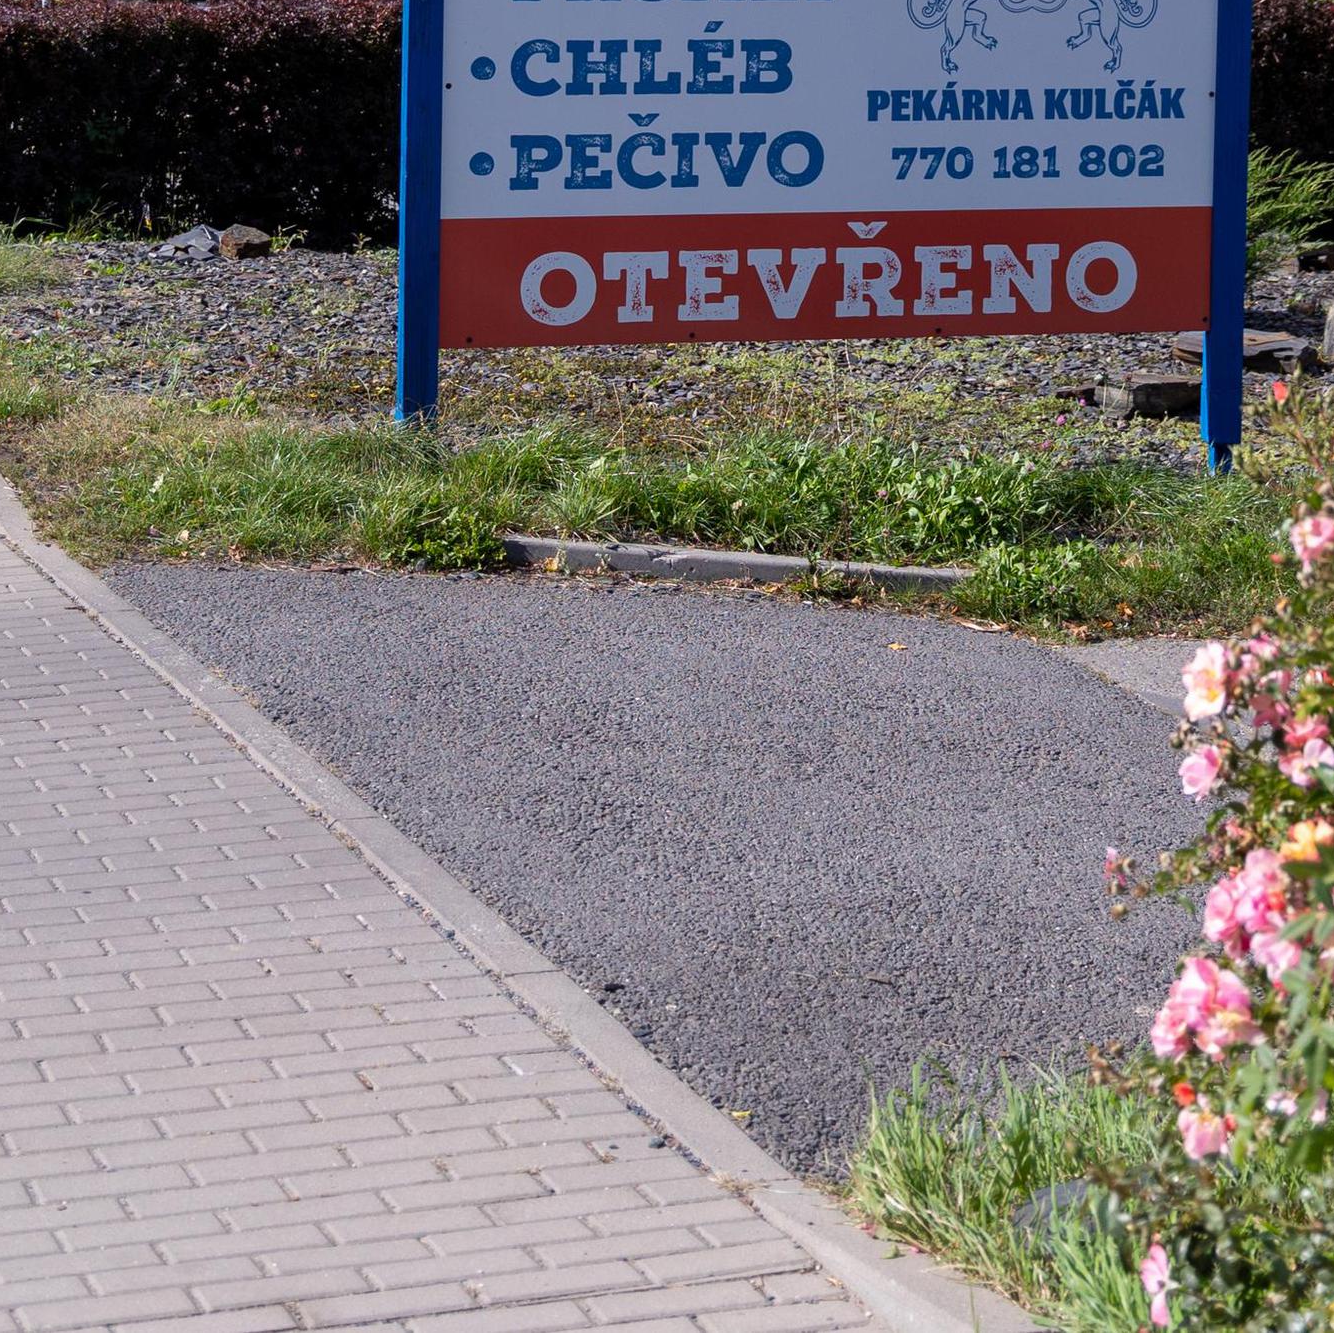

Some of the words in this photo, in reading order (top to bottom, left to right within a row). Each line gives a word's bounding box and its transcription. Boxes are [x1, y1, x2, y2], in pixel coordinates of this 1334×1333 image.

[510, 20, 794, 97] CHLÉB
[866, 81, 1034, 122] PEKÁRNA
[1044, 79, 1185, 120] KULČÁK
[508, 112, 825, 191] PEČIVO
[891, 146, 975, 182] 770
[992, 145, 1061, 180] 181
[1077, 143, 1165, 179] 802
[519, 220, 1138, 327] OTEVŘENO
